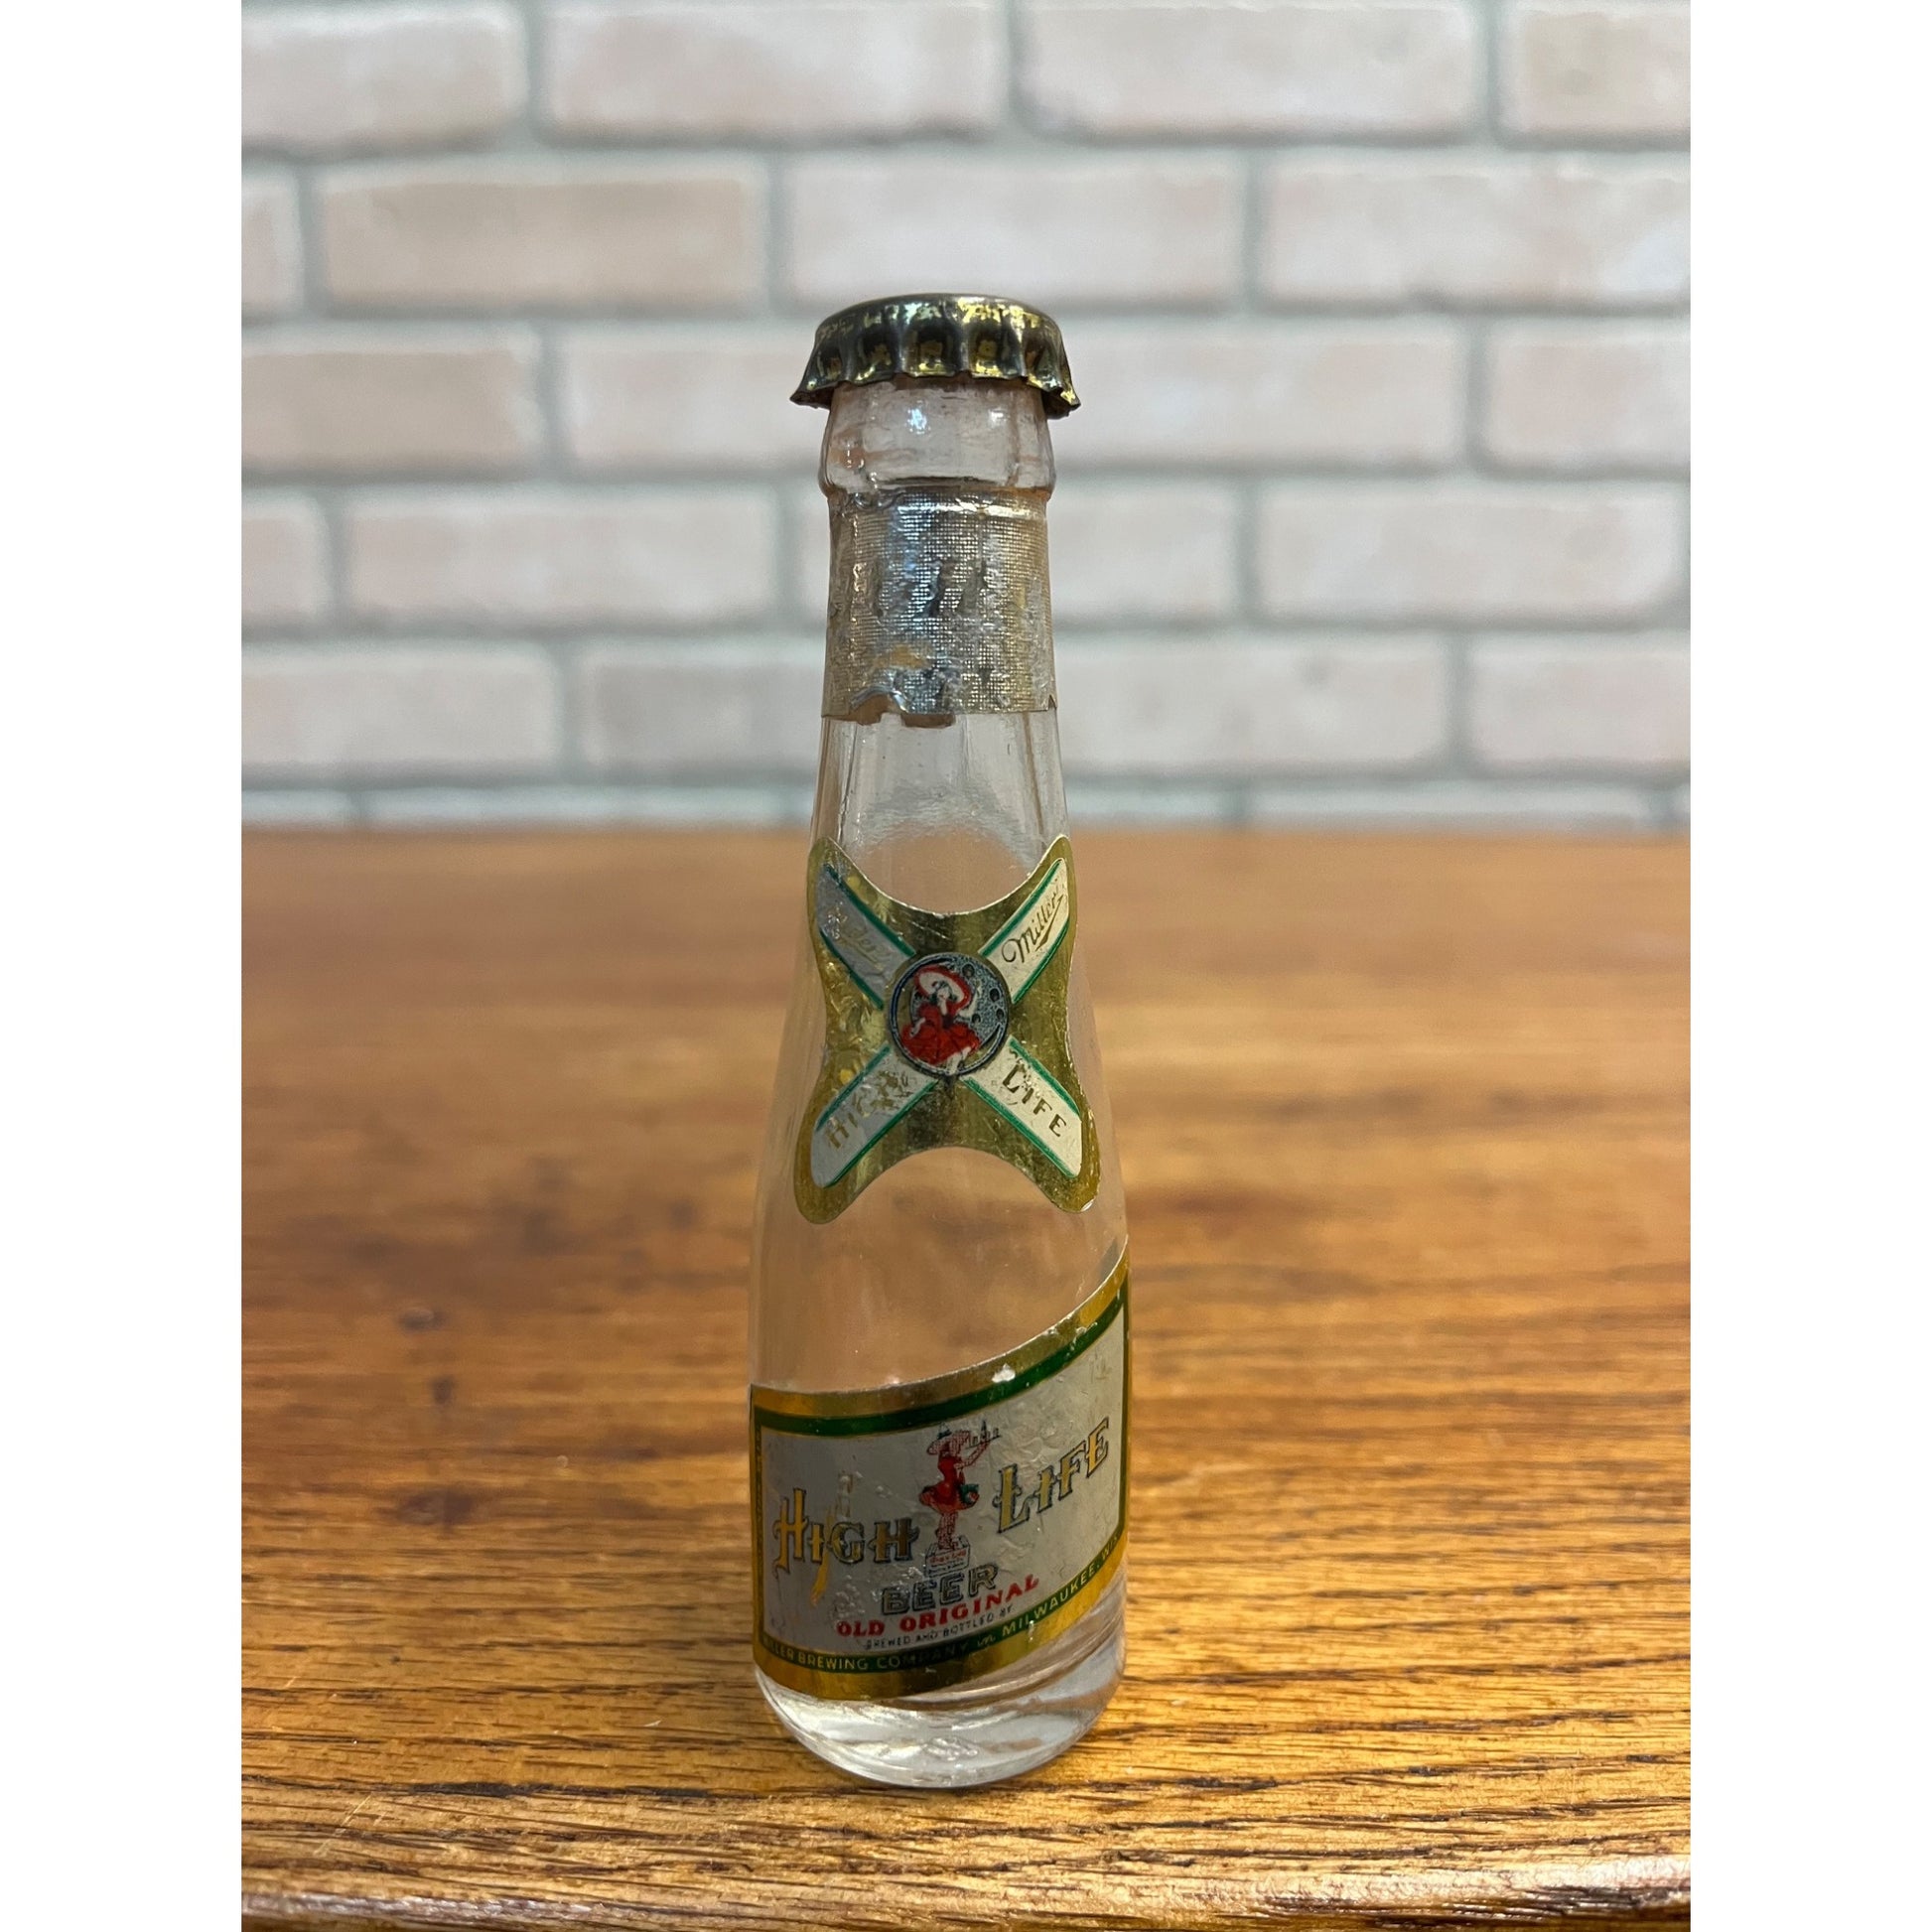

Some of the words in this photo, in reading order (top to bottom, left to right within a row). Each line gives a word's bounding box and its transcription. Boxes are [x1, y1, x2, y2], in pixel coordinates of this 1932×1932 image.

[1003, 890, 1064, 964] Miller
[1002, 1058, 1067, 1138] LIFE
[774, 1487, 919, 1575] HIGH
[993, 1416, 1111, 1533] LIFE
[835, 1619, 885, 1638] OLD
[899, 1574, 1039, 1633] ORIGINAL
[881, 1563, 999, 1616] BEER
[798, 1652, 869, 1671] BREWING
[876, 1641, 970, 1669] COMPANY
[865, 1638, 911, 1650] BREWED
[915, 1630, 939, 1642] AND
[942, 1613, 994, 1637] BOTTLED
